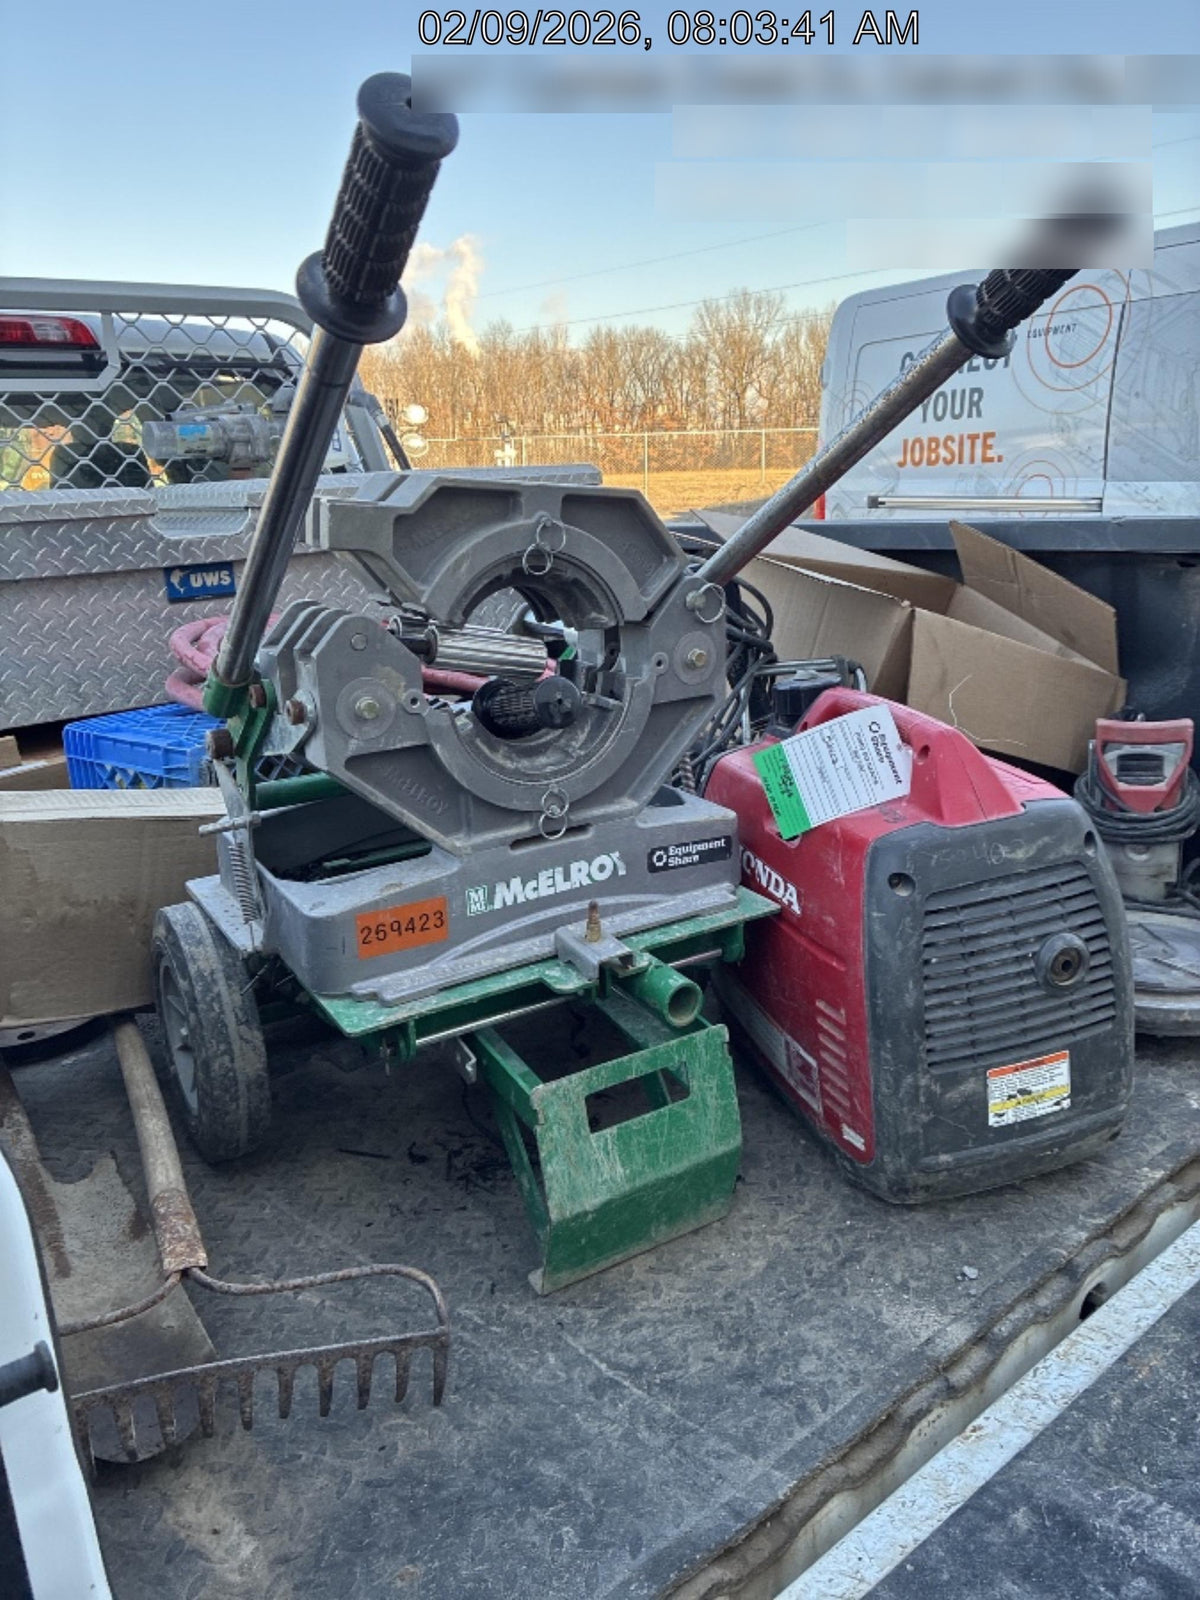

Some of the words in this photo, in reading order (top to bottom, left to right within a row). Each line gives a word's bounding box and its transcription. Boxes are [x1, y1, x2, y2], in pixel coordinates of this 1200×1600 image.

[1027, 323, 1077, 339] EQUIPMENT
[920, 387, 984, 423] YOUR
[897, 431, 1003, 467] JOBSITE.
[189, 570, 231, 588] UWS
[667, 838, 726, 856] Equipment
[667, 854, 700, 867] Share
[493, 850, 627, 910] McELROY
[740, 845, 801, 914] ONDA
[360, 910, 444, 945] 269423
